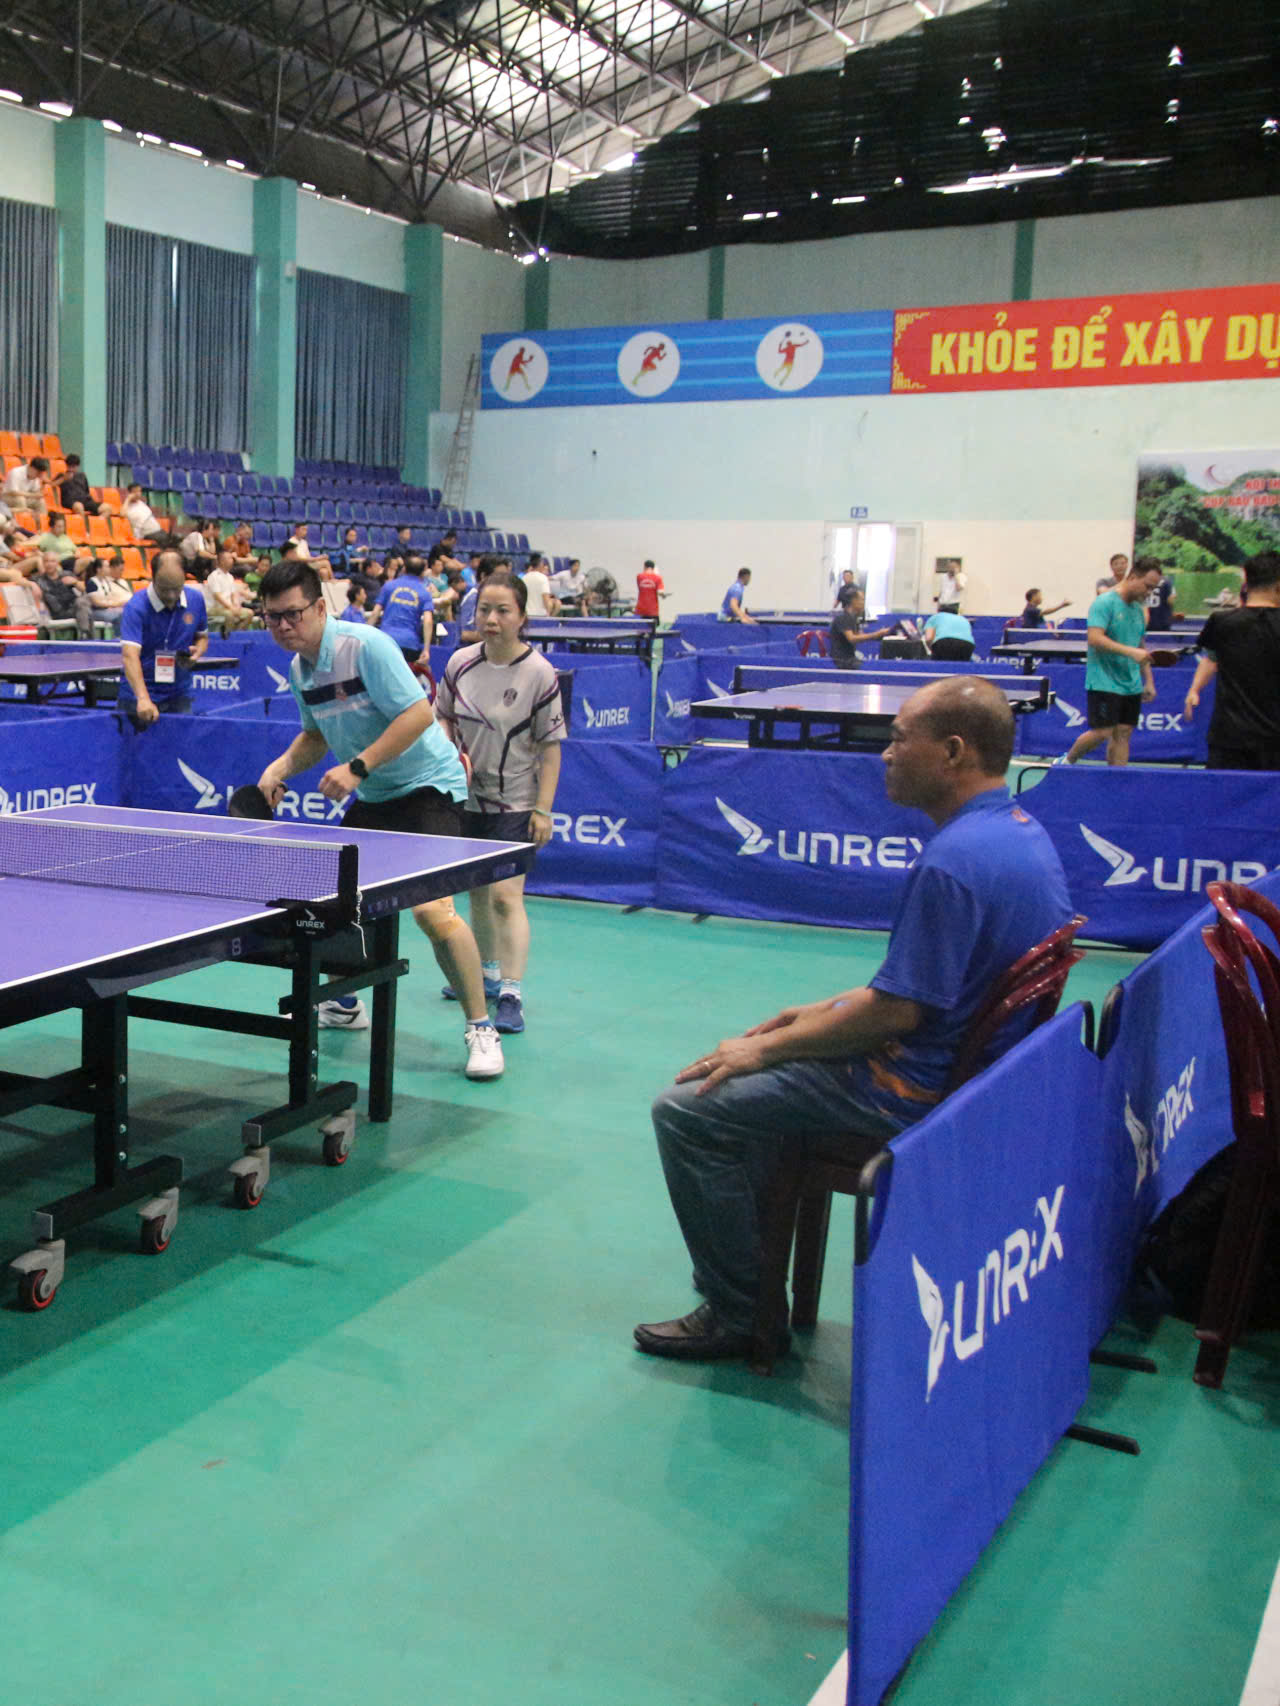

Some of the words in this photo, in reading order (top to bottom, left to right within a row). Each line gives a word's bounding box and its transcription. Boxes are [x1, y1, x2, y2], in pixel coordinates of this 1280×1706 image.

[930, 311, 1038, 375] KHỎE
[1051, 305, 1112, 370] ĐỂ
[1120, 309, 1213, 367] XÂY
[595, 706, 630, 728] UNREX
[296, 919, 325, 929] UNREX
